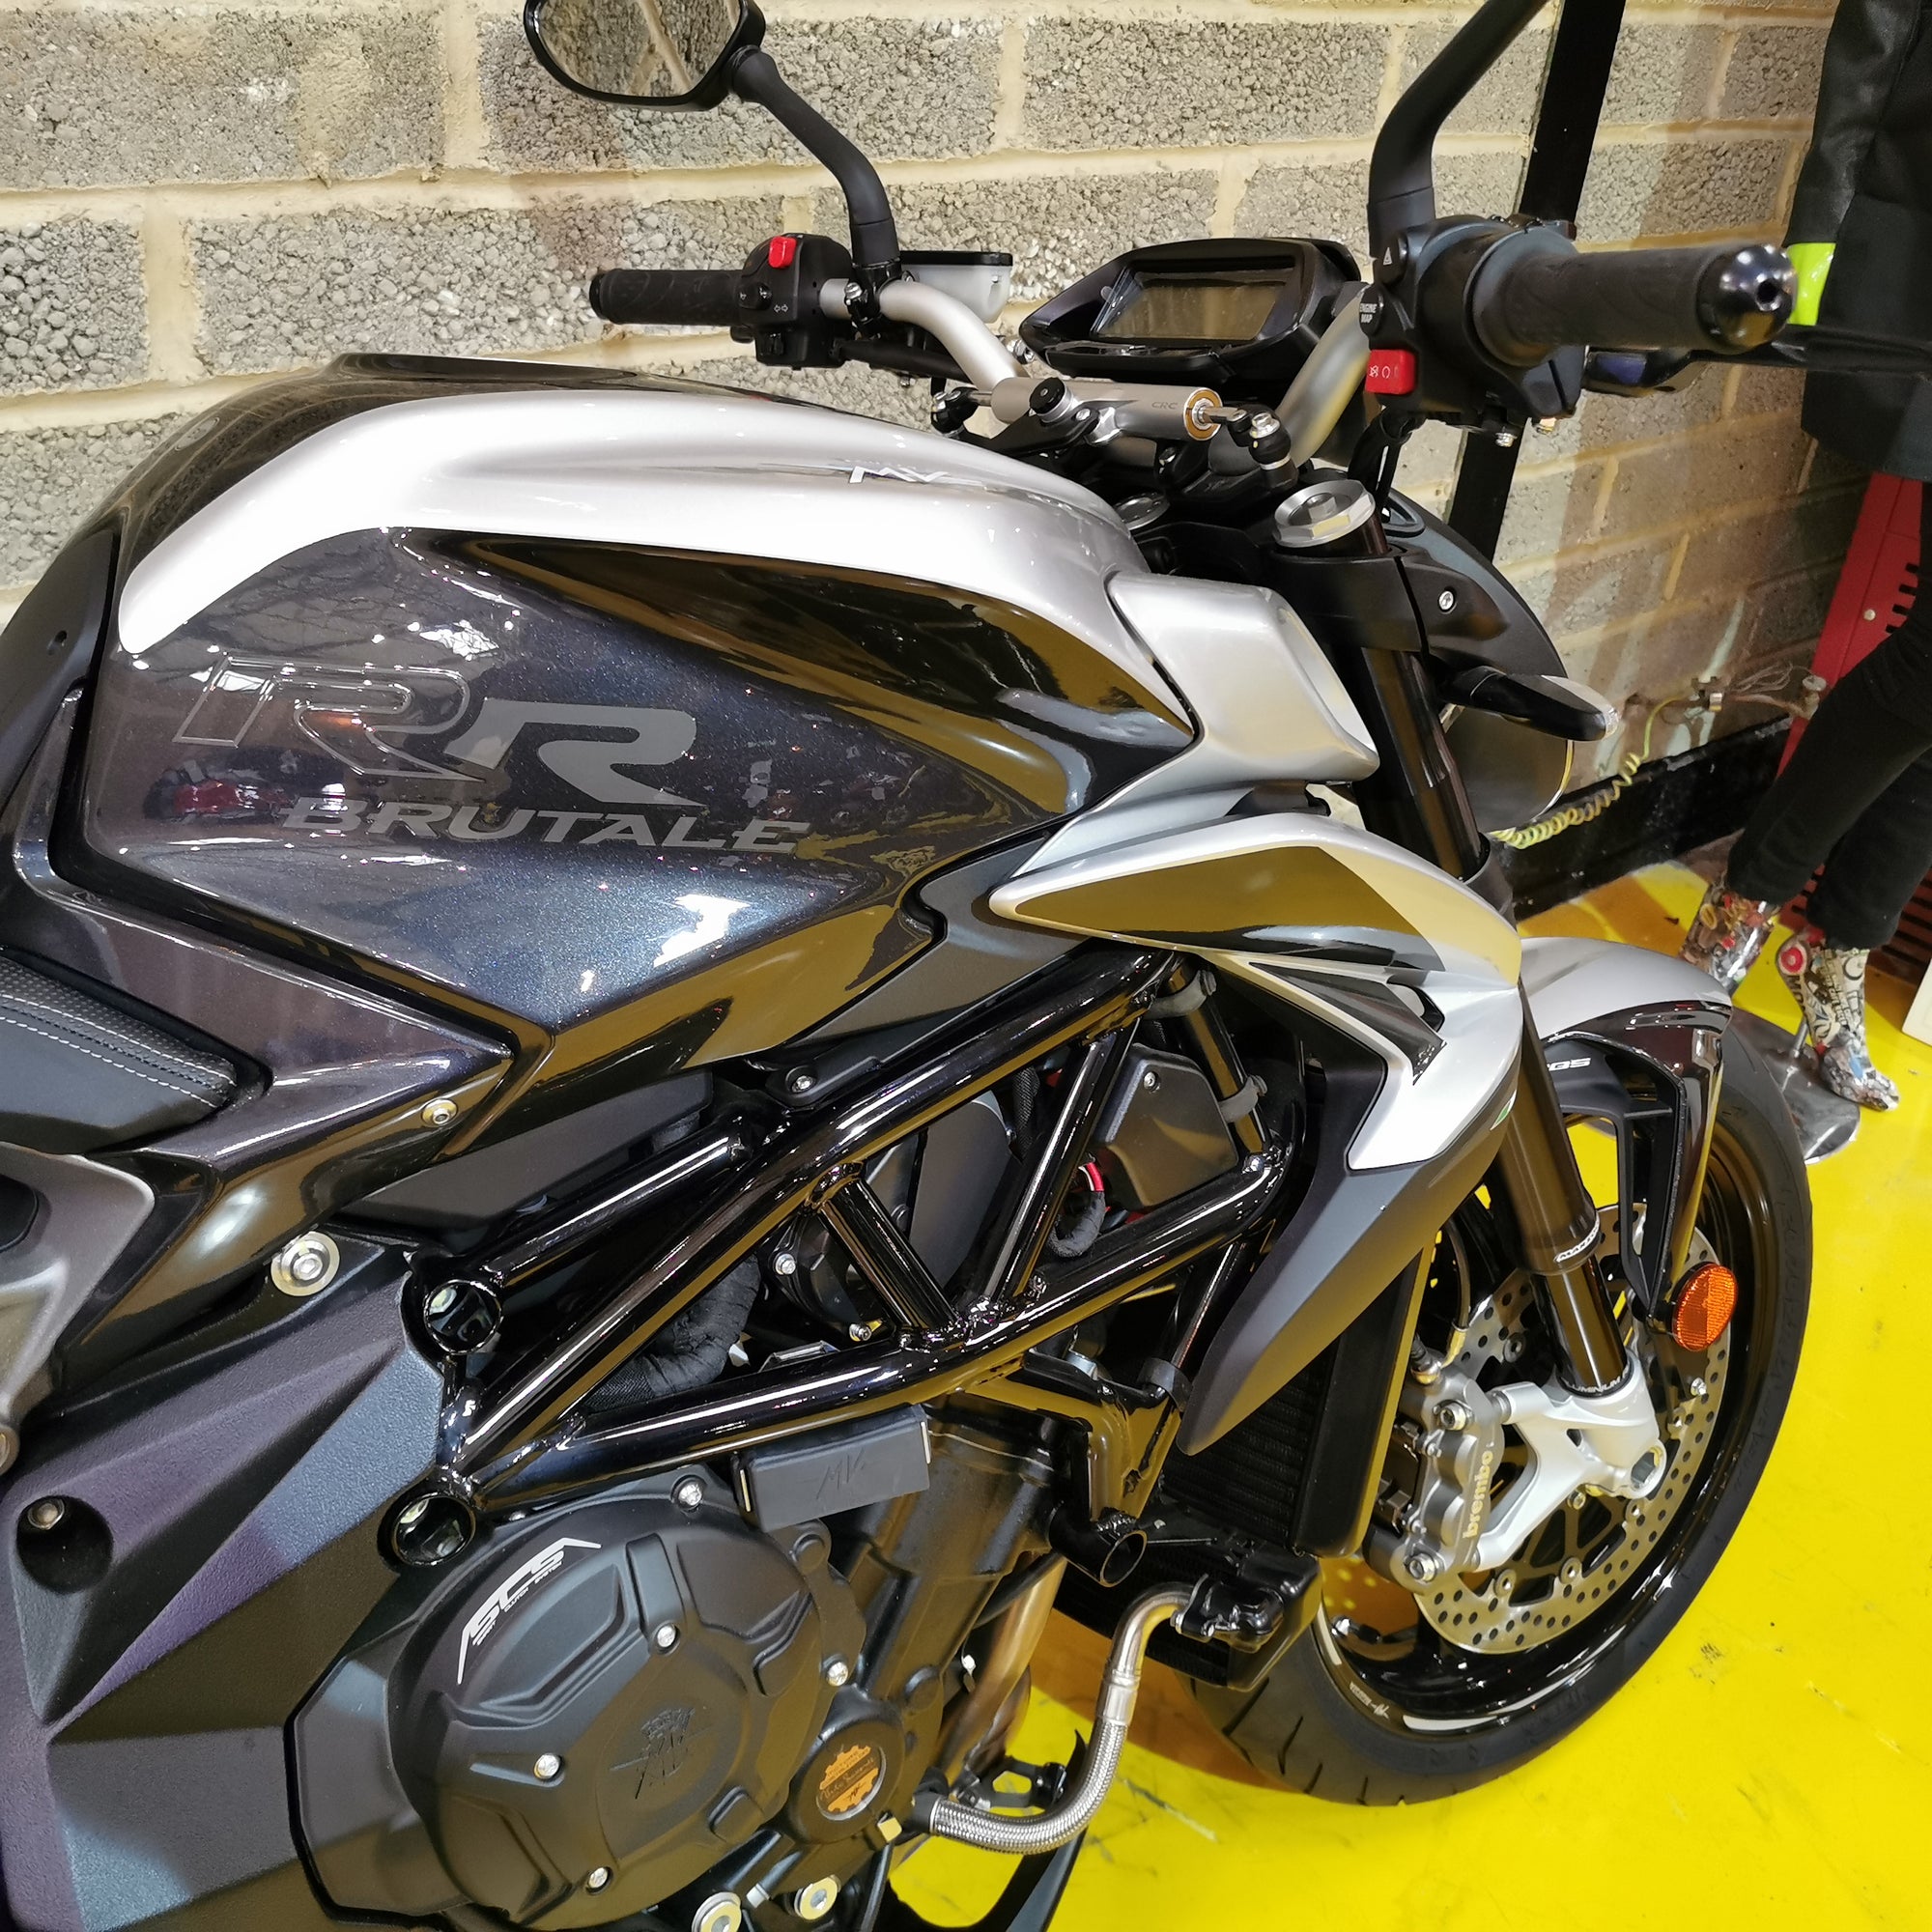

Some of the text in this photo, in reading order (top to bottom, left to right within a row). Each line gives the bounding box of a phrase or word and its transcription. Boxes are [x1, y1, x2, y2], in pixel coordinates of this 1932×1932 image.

[1151, 401, 1179, 411] CRC
[282, 797, 810, 854] BRUTALE
[1547, 1057, 1592, 1071] BS
[1462, 1450, 1493, 1539] brembo
